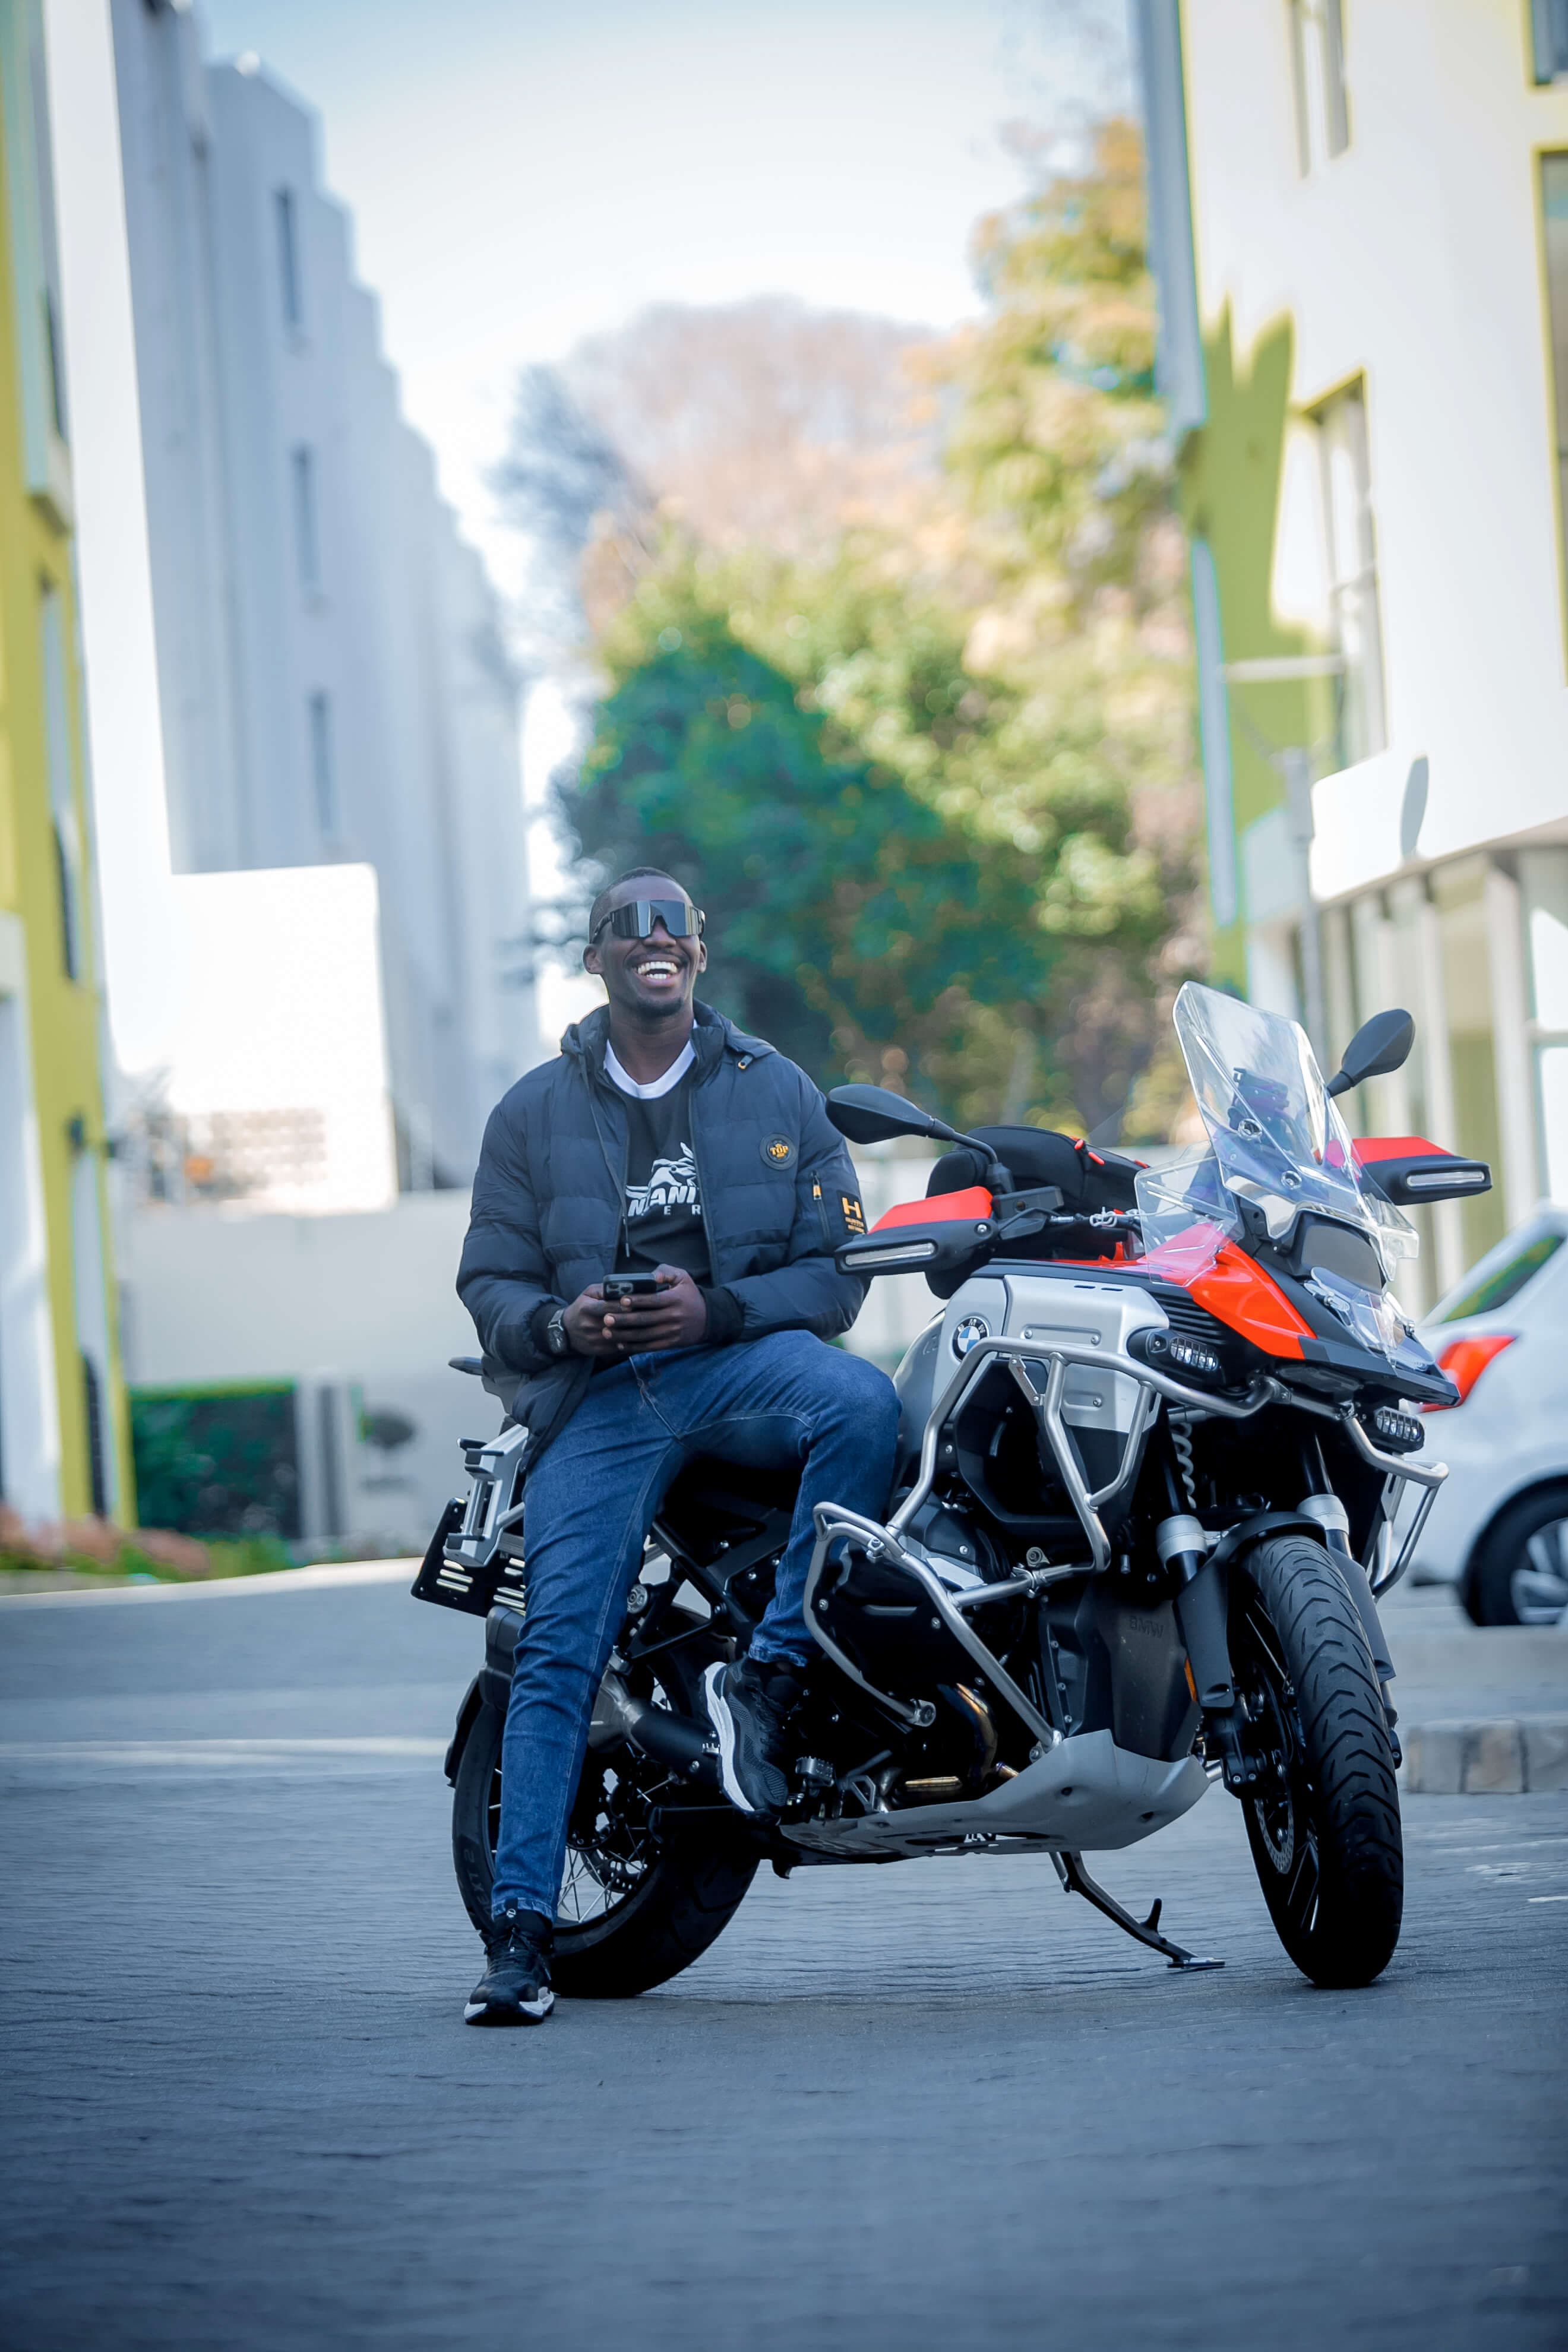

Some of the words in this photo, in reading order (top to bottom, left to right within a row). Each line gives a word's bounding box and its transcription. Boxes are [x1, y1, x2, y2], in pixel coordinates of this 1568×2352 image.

[770, 1143, 789, 1156] TOP
[842, 1197, 862, 1219] H
[957, 1319, 986, 1333] BMW
[1130, 1616, 1164, 1639] BMW
